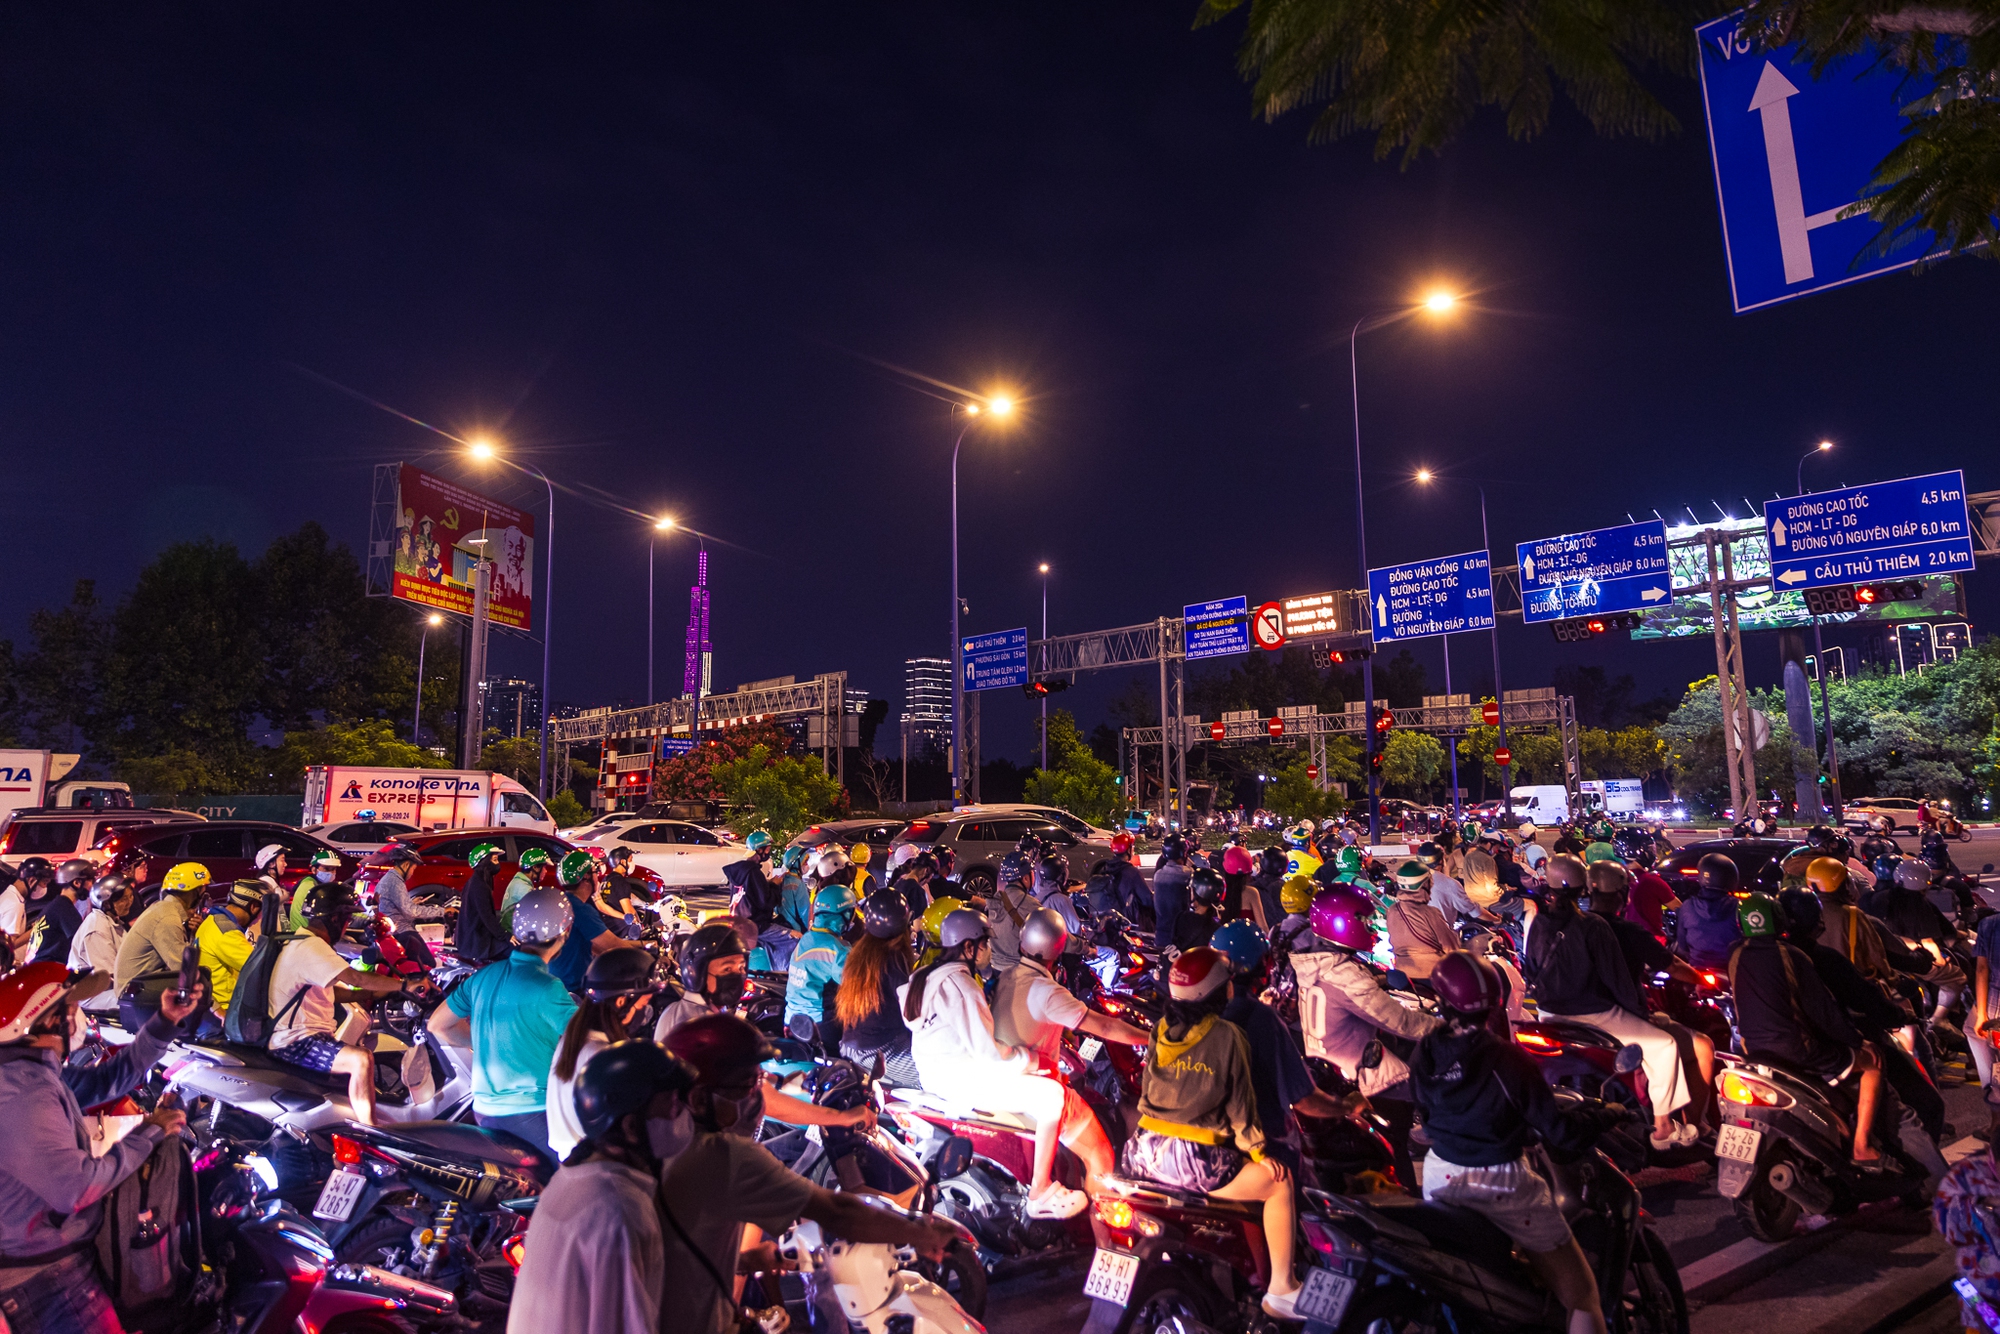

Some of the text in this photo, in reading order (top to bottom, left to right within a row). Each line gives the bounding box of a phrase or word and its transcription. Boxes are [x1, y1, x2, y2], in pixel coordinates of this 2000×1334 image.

[1788, 490, 1960, 519] ĐƯỜNG CAO TỐC 4.5 km
[1790, 514, 1858, 535] HCM LT DG
[1792, 519, 1960, 552] ĐƯỜNG VÕ NGUYÊN GIÁP 6.0 km
[1536, 533, 1662, 556] ĐƯỜNG CAO TỐC 4.5 km
[1389, 568, 1414, 584] ĐỒNG
[1414, 565, 1433, 579] VĂN
[1434, 560, 1459, 576] CỐNG
[1476, 558, 1488, 568] km
[1537, 558, 1554, 570] HCM
[1576, 552, 1588, 564] DG
[1538, 570, 1566, 585] ĐƯỜNG
[1580, 564, 1612, 578] NGUYÊN
[1636, 558, 1649, 570] 6.0
[1650, 557, 1666, 568] km
[1815, 550, 1969, 580] CẦU THỦ THIÊM 2.0 km
[1390, 574, 1459, 597] ĐƯỜNG CAO TỐC
[1391, 598, 1410, 610] HCM
[1418, 594, 1428, 606] LT
[1435, 592, 1448, 603] DG
[1478, 588, 1490, 598] km
[1392, 609, 1422, 624] ĐƯỜNG
[1394, 624, 1406, 636] VÕ
[1407, 618, 1442, 634] NGUYÊN
[1444, 617, 1465, 630] GIÁP
[1480, 616, 1493, 626] km
[367, 793, 436, 804] EXPRESS
[197, 806, 237, 817] CITY
[576, 860, 591, 872] Grab
[1721, 1142, 1752, 1159] 6287
[320, 1195, 350, 1216] 2867
[1087, 1274, 1129, 1302] 968.93
[1302, 1292, 1340, 1317] 7136
